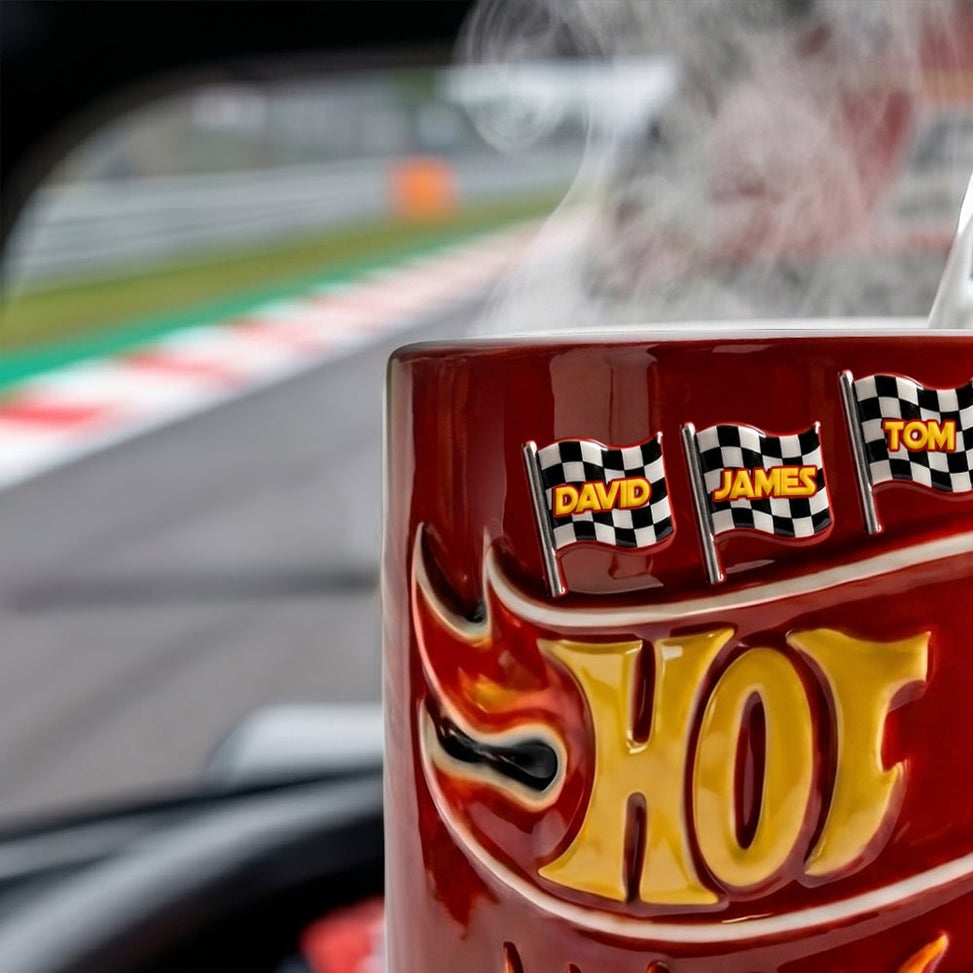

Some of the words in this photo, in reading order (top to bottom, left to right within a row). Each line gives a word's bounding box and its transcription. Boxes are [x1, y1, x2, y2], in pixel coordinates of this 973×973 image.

[883, 419, 957, 451] TOM
[553, 477, 651, 516] DAVID
[713, 466, 818, 500] JAMES
[536, 626, 932, 906] HOT
